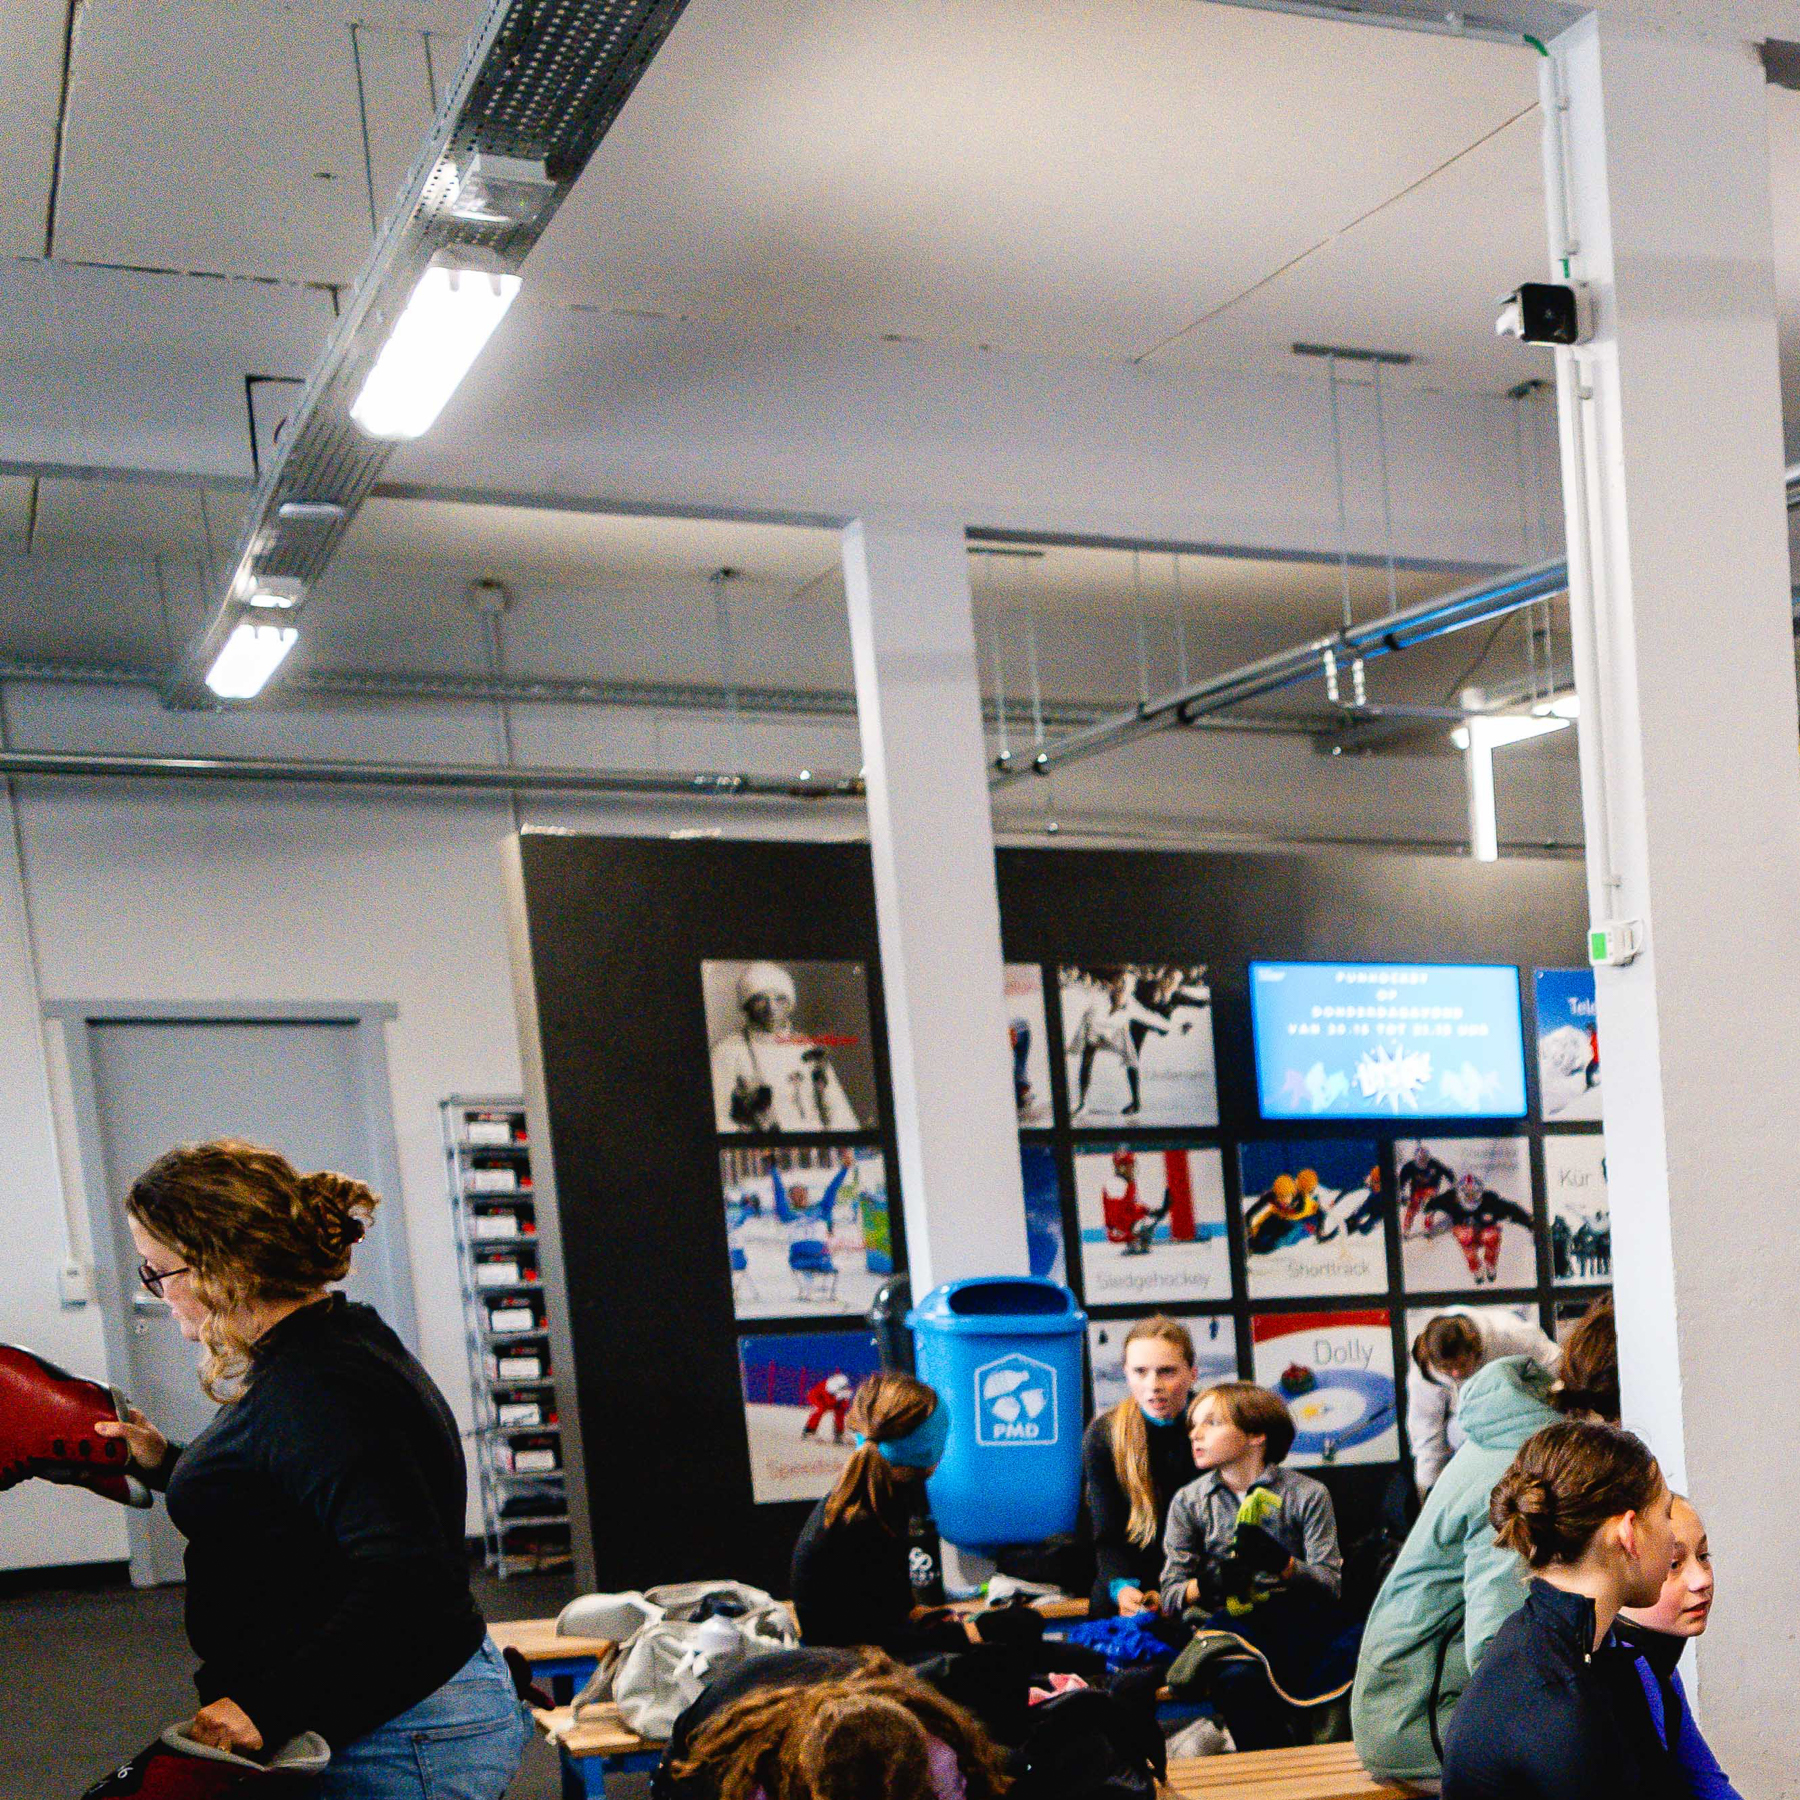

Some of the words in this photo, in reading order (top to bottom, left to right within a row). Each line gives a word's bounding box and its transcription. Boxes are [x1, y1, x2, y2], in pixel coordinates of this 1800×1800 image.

[1559, 1168, 1590, 1187] Kür
[1315, 1337, 1374, 1371] Dolly
[992, 1424, 1040, 1440] PMD
